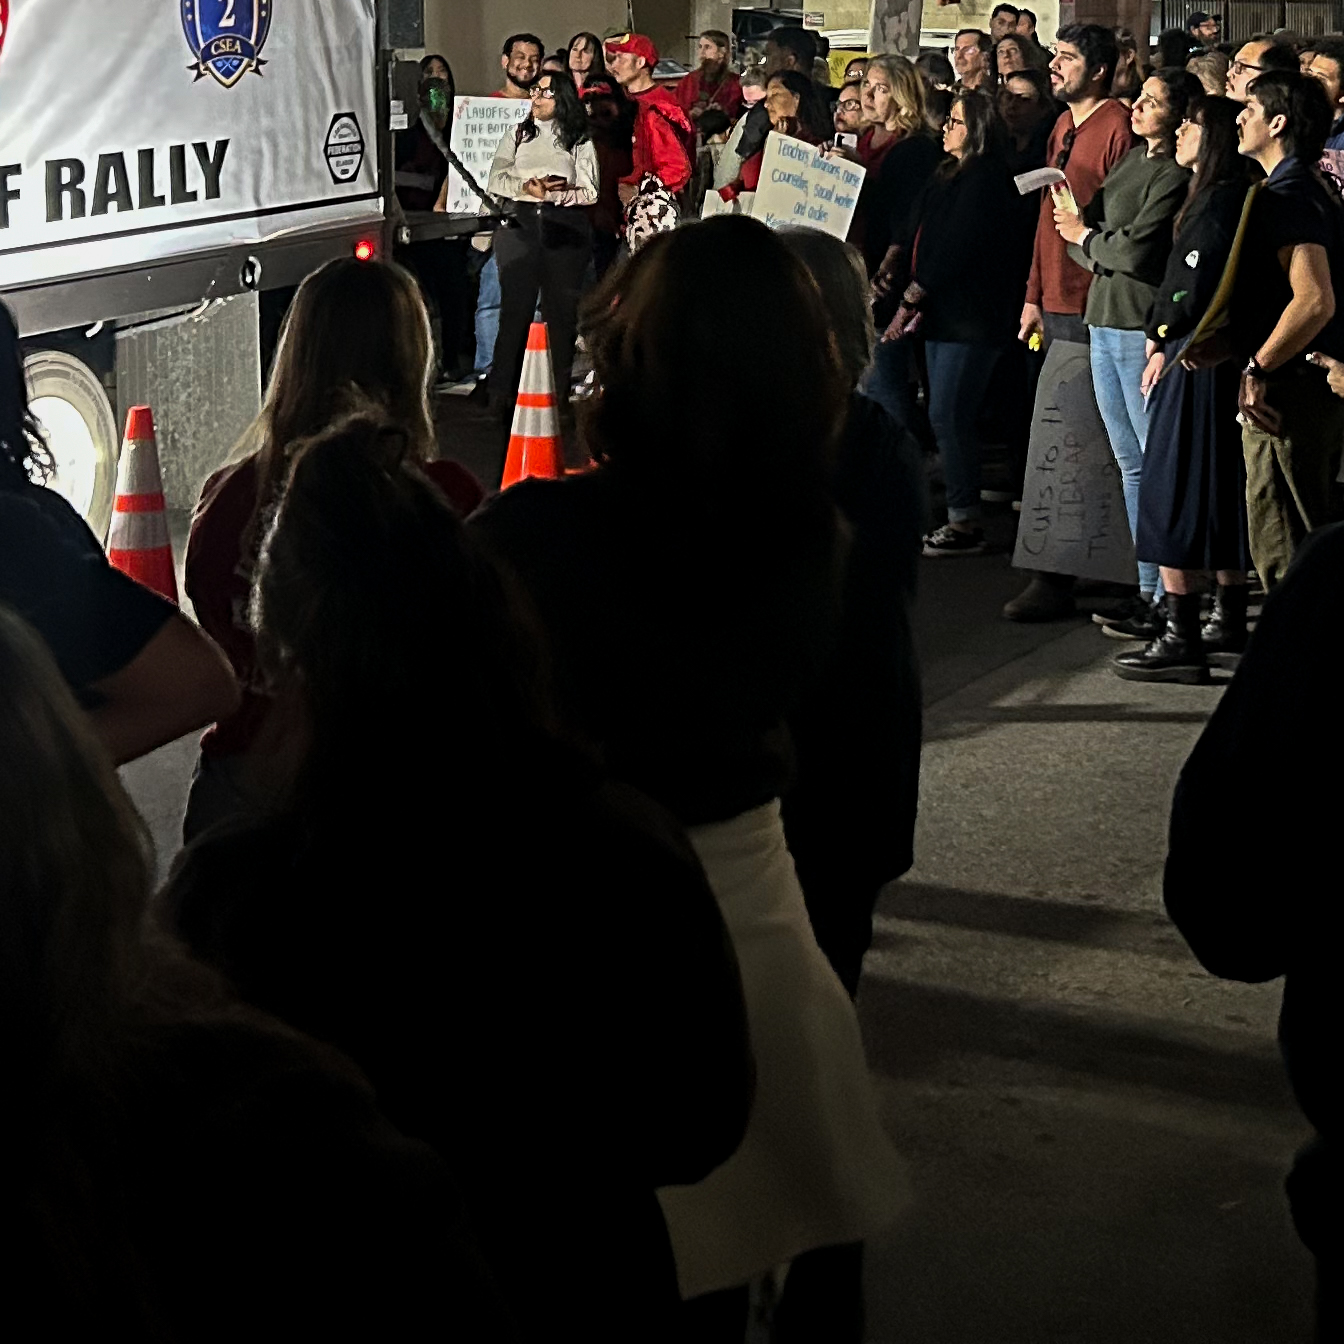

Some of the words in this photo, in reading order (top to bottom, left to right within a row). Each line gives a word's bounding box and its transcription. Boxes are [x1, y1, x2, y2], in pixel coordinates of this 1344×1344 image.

[210, 38, 242, 56] CSEA
[466, 106, 510, 120] LAYOFFS
[465, 123, 483, 135] THE
[462, 137, 474, 148] TO
[460, 150, 477, 163] THE
[44, 137, 231, 224] RALLY
[1035, 444, 1059, 473] to
[1021, 484, 1054, 556] Cuts
